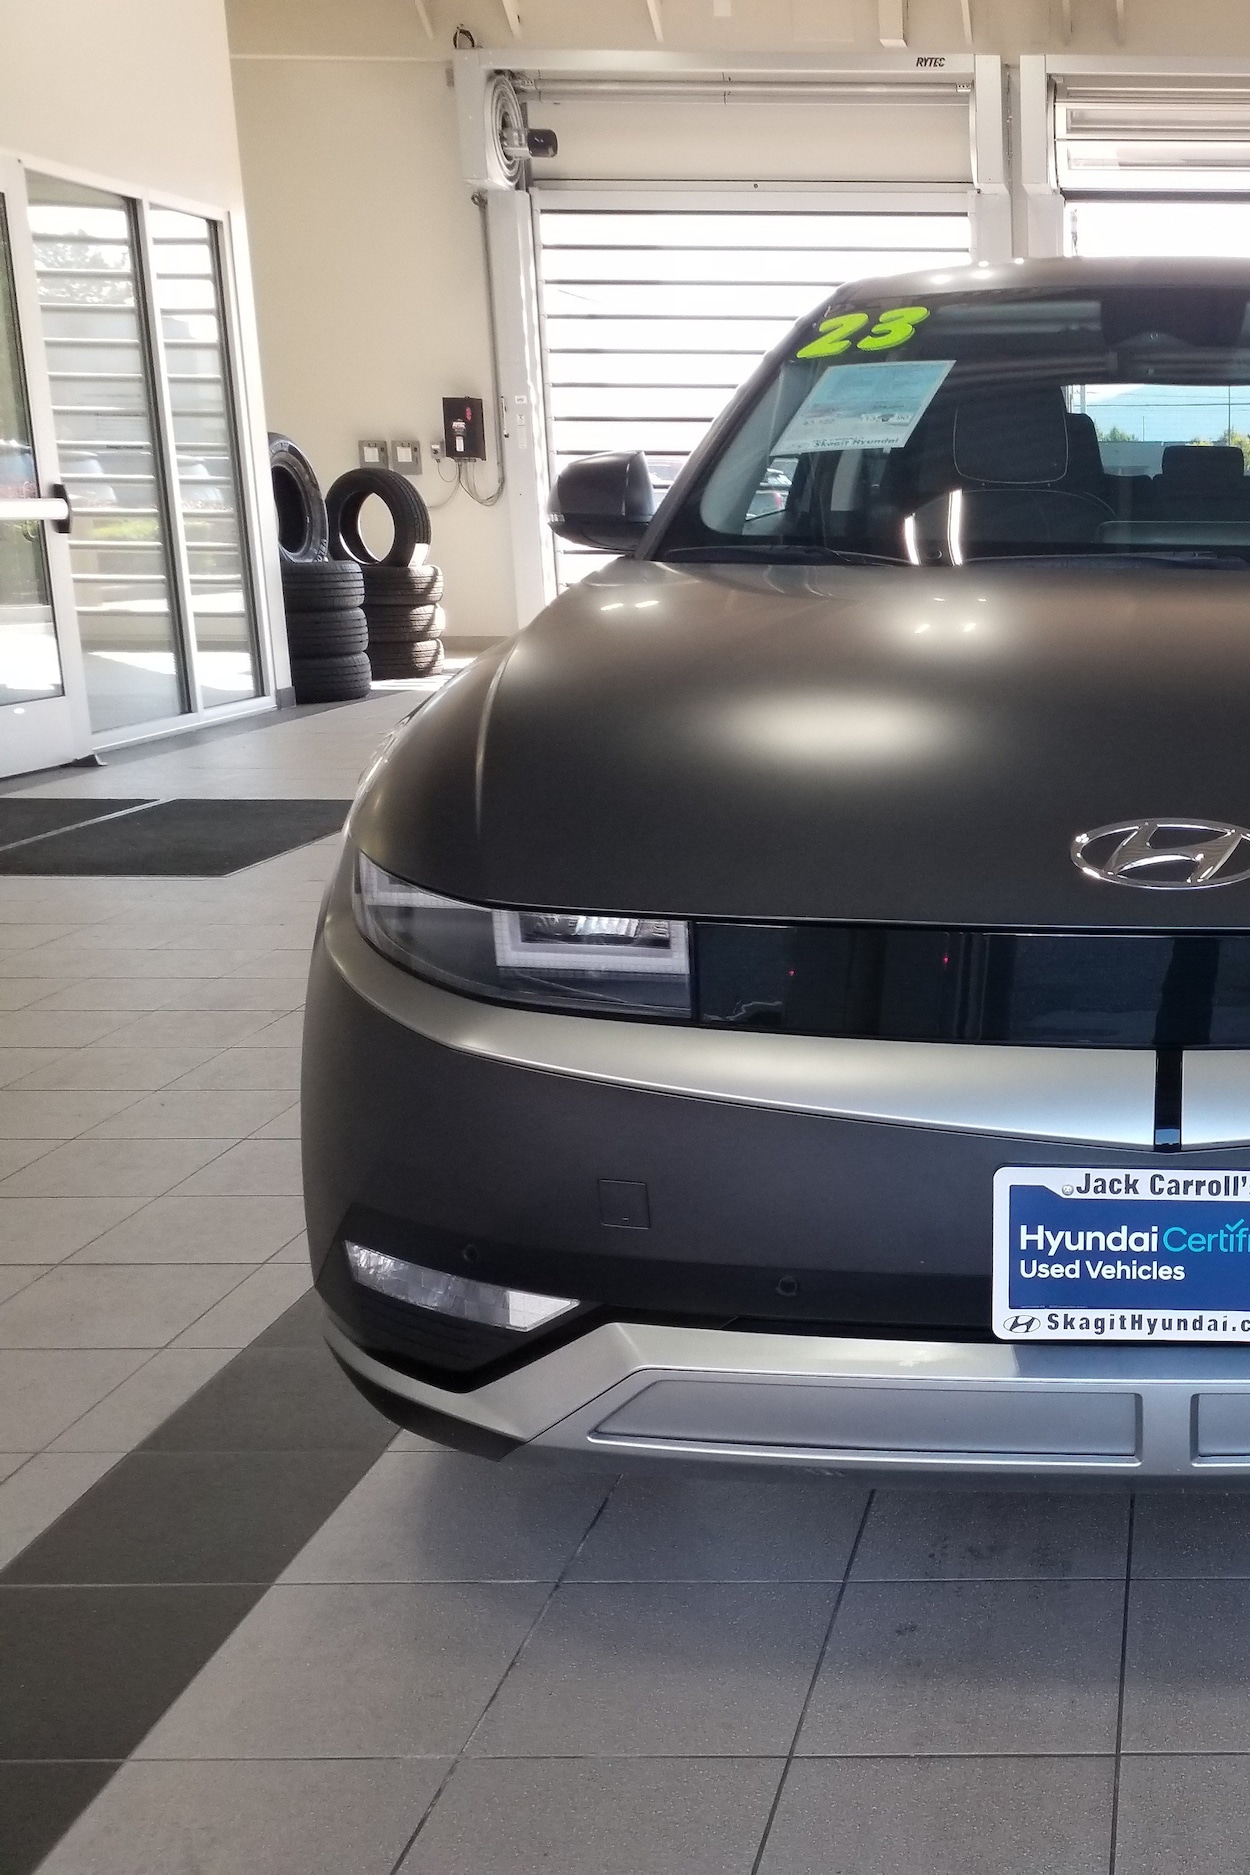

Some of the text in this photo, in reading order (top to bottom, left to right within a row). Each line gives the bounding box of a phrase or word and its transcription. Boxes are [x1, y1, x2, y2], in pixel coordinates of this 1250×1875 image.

[915, 56, 946, 68] RYTEC
[796, 306, 931, 359] 23
[1076, 1173, 1140, 1195] Jack
[1020, 1224, 1159, 1256] Hyundai
[1020, 1259, 1186, 1281] Used Vehicles
